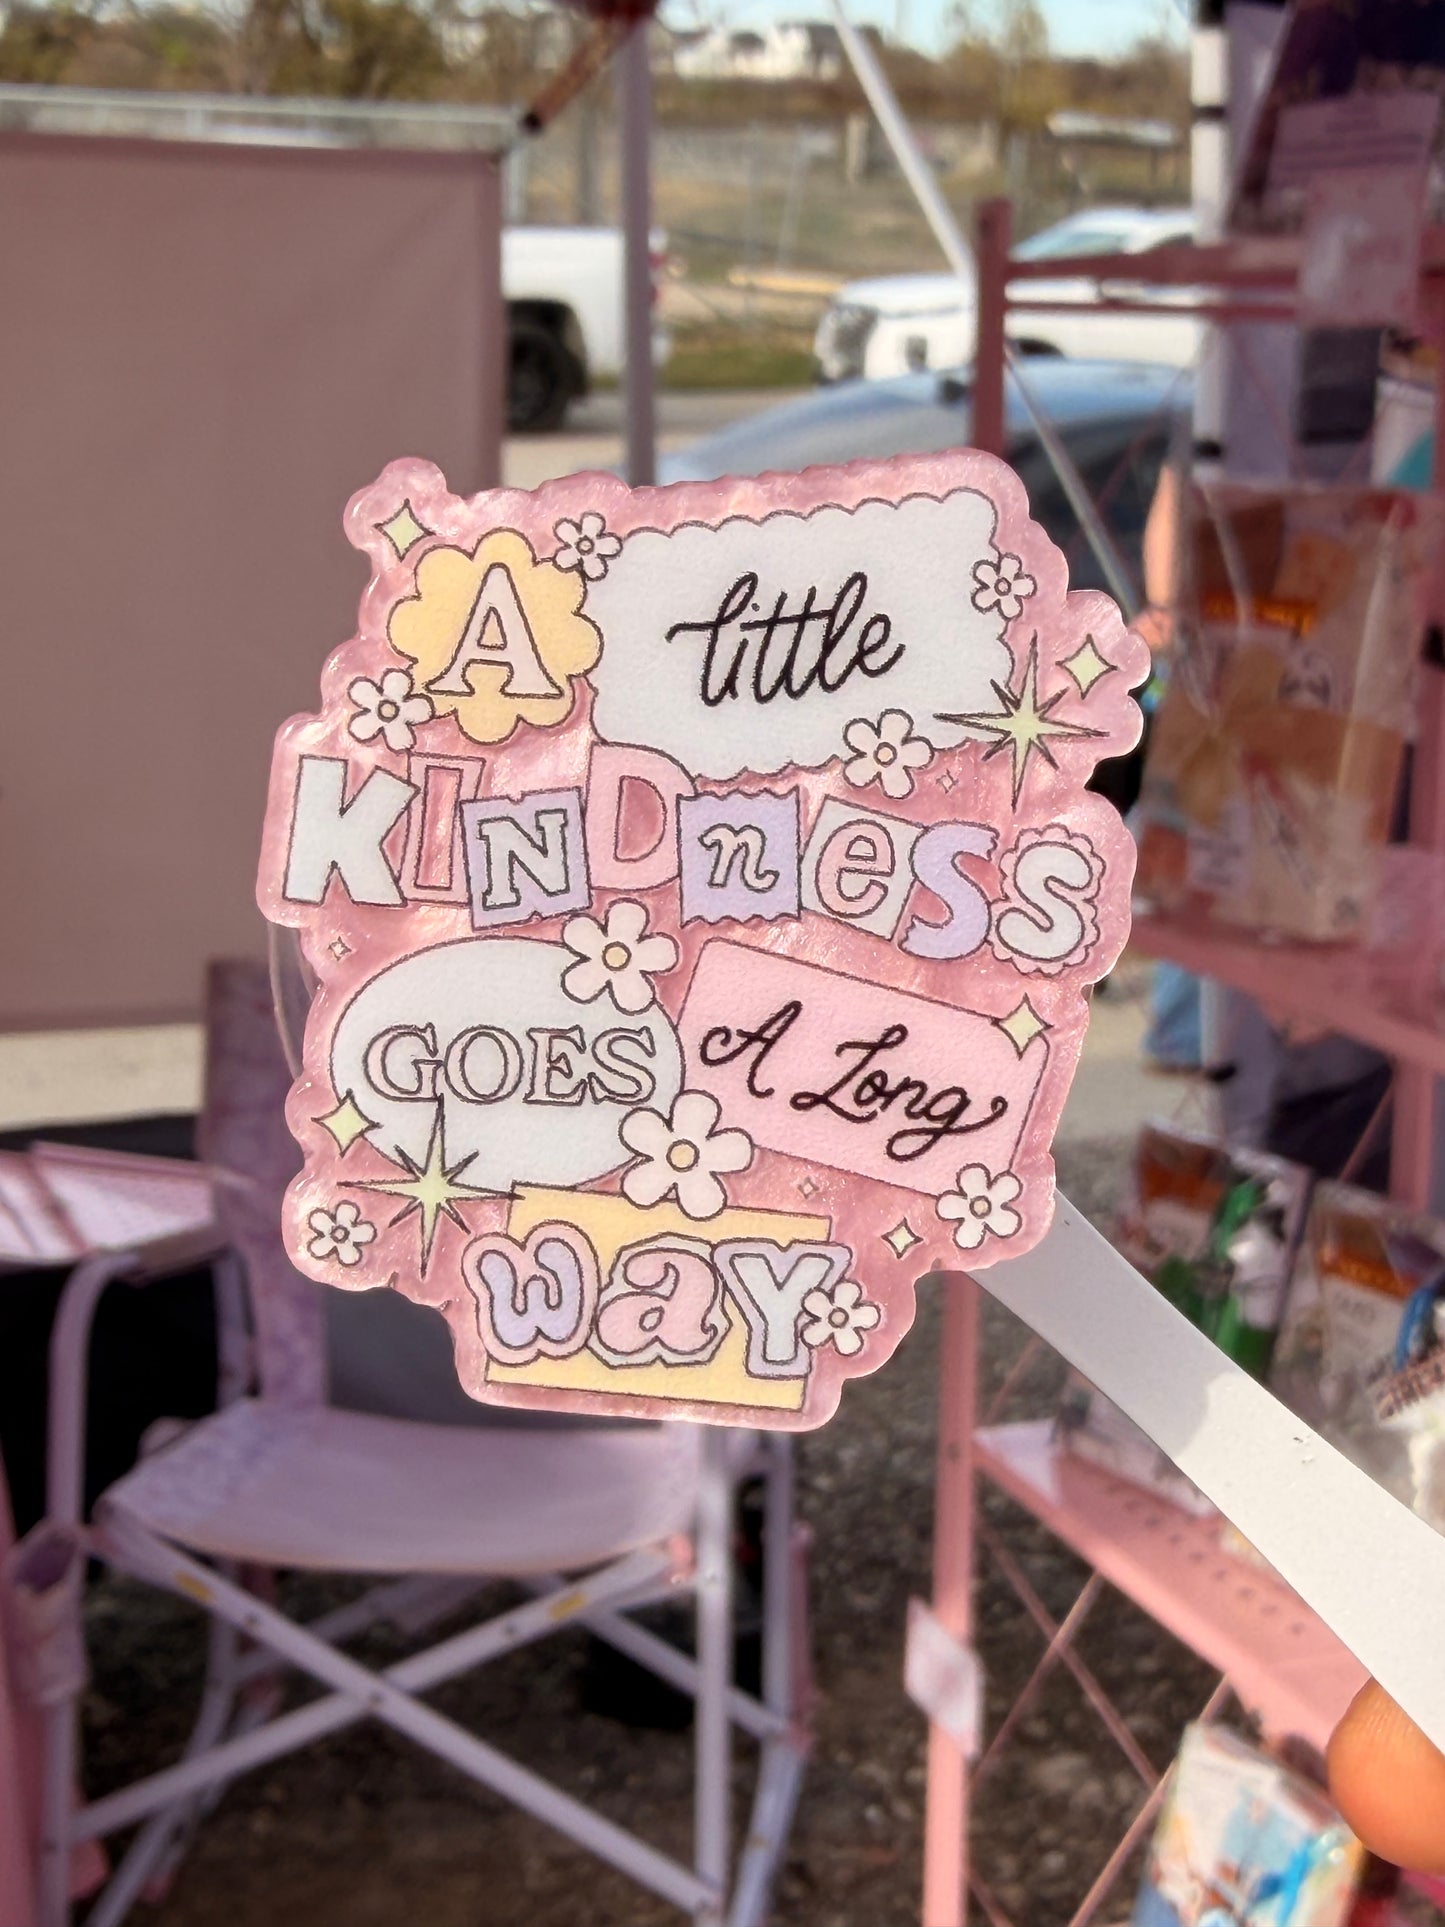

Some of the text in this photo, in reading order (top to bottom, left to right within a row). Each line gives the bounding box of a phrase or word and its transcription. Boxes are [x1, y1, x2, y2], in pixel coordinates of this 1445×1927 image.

[424, 562, 906, 707] A little
[362, 999, 1009, 1162] GOES A Long
